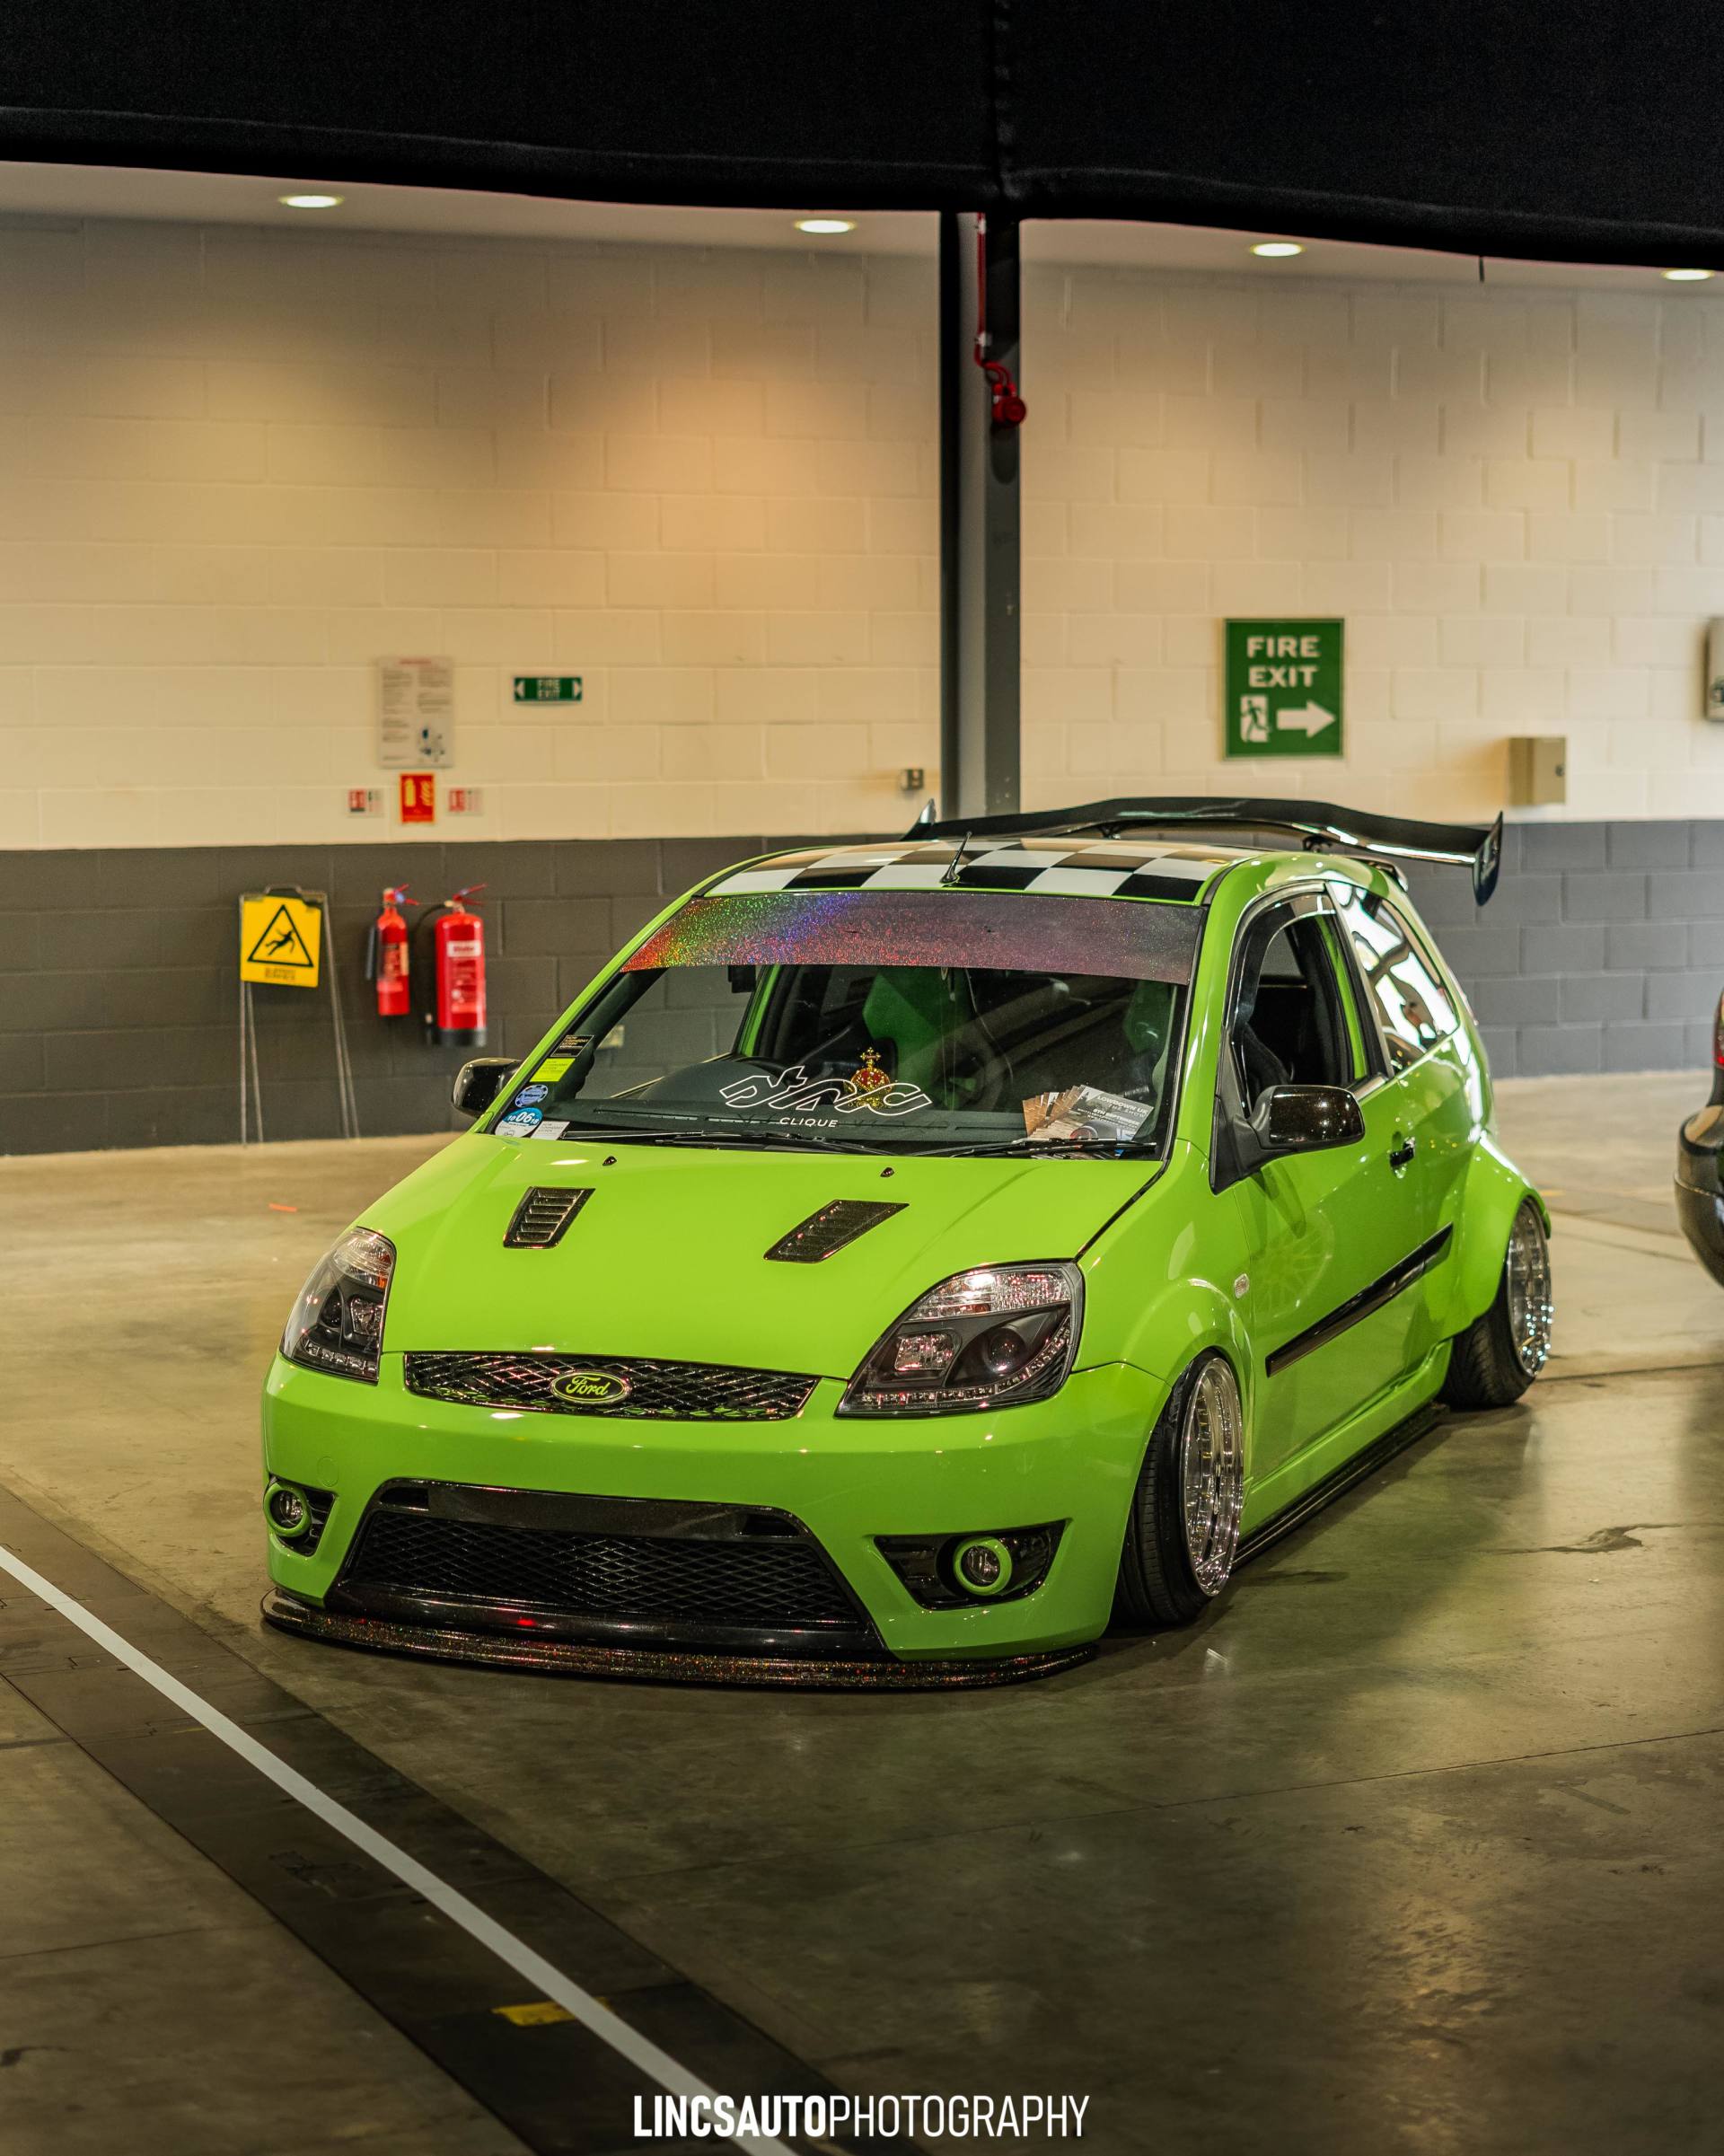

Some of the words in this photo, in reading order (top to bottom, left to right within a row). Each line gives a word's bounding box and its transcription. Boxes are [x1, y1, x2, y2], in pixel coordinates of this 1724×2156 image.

[1247, 636, 1322, 658] FIRE
[1249, 666, 1318, 688] EXIT
[1097, 1096, 1138, 1111] LOWDOWN
[515, 1111, 535, 1123] 06
[779, 1117, 839, 1128] CLIQUE
[566, 1376, 611, 1395] Ford
